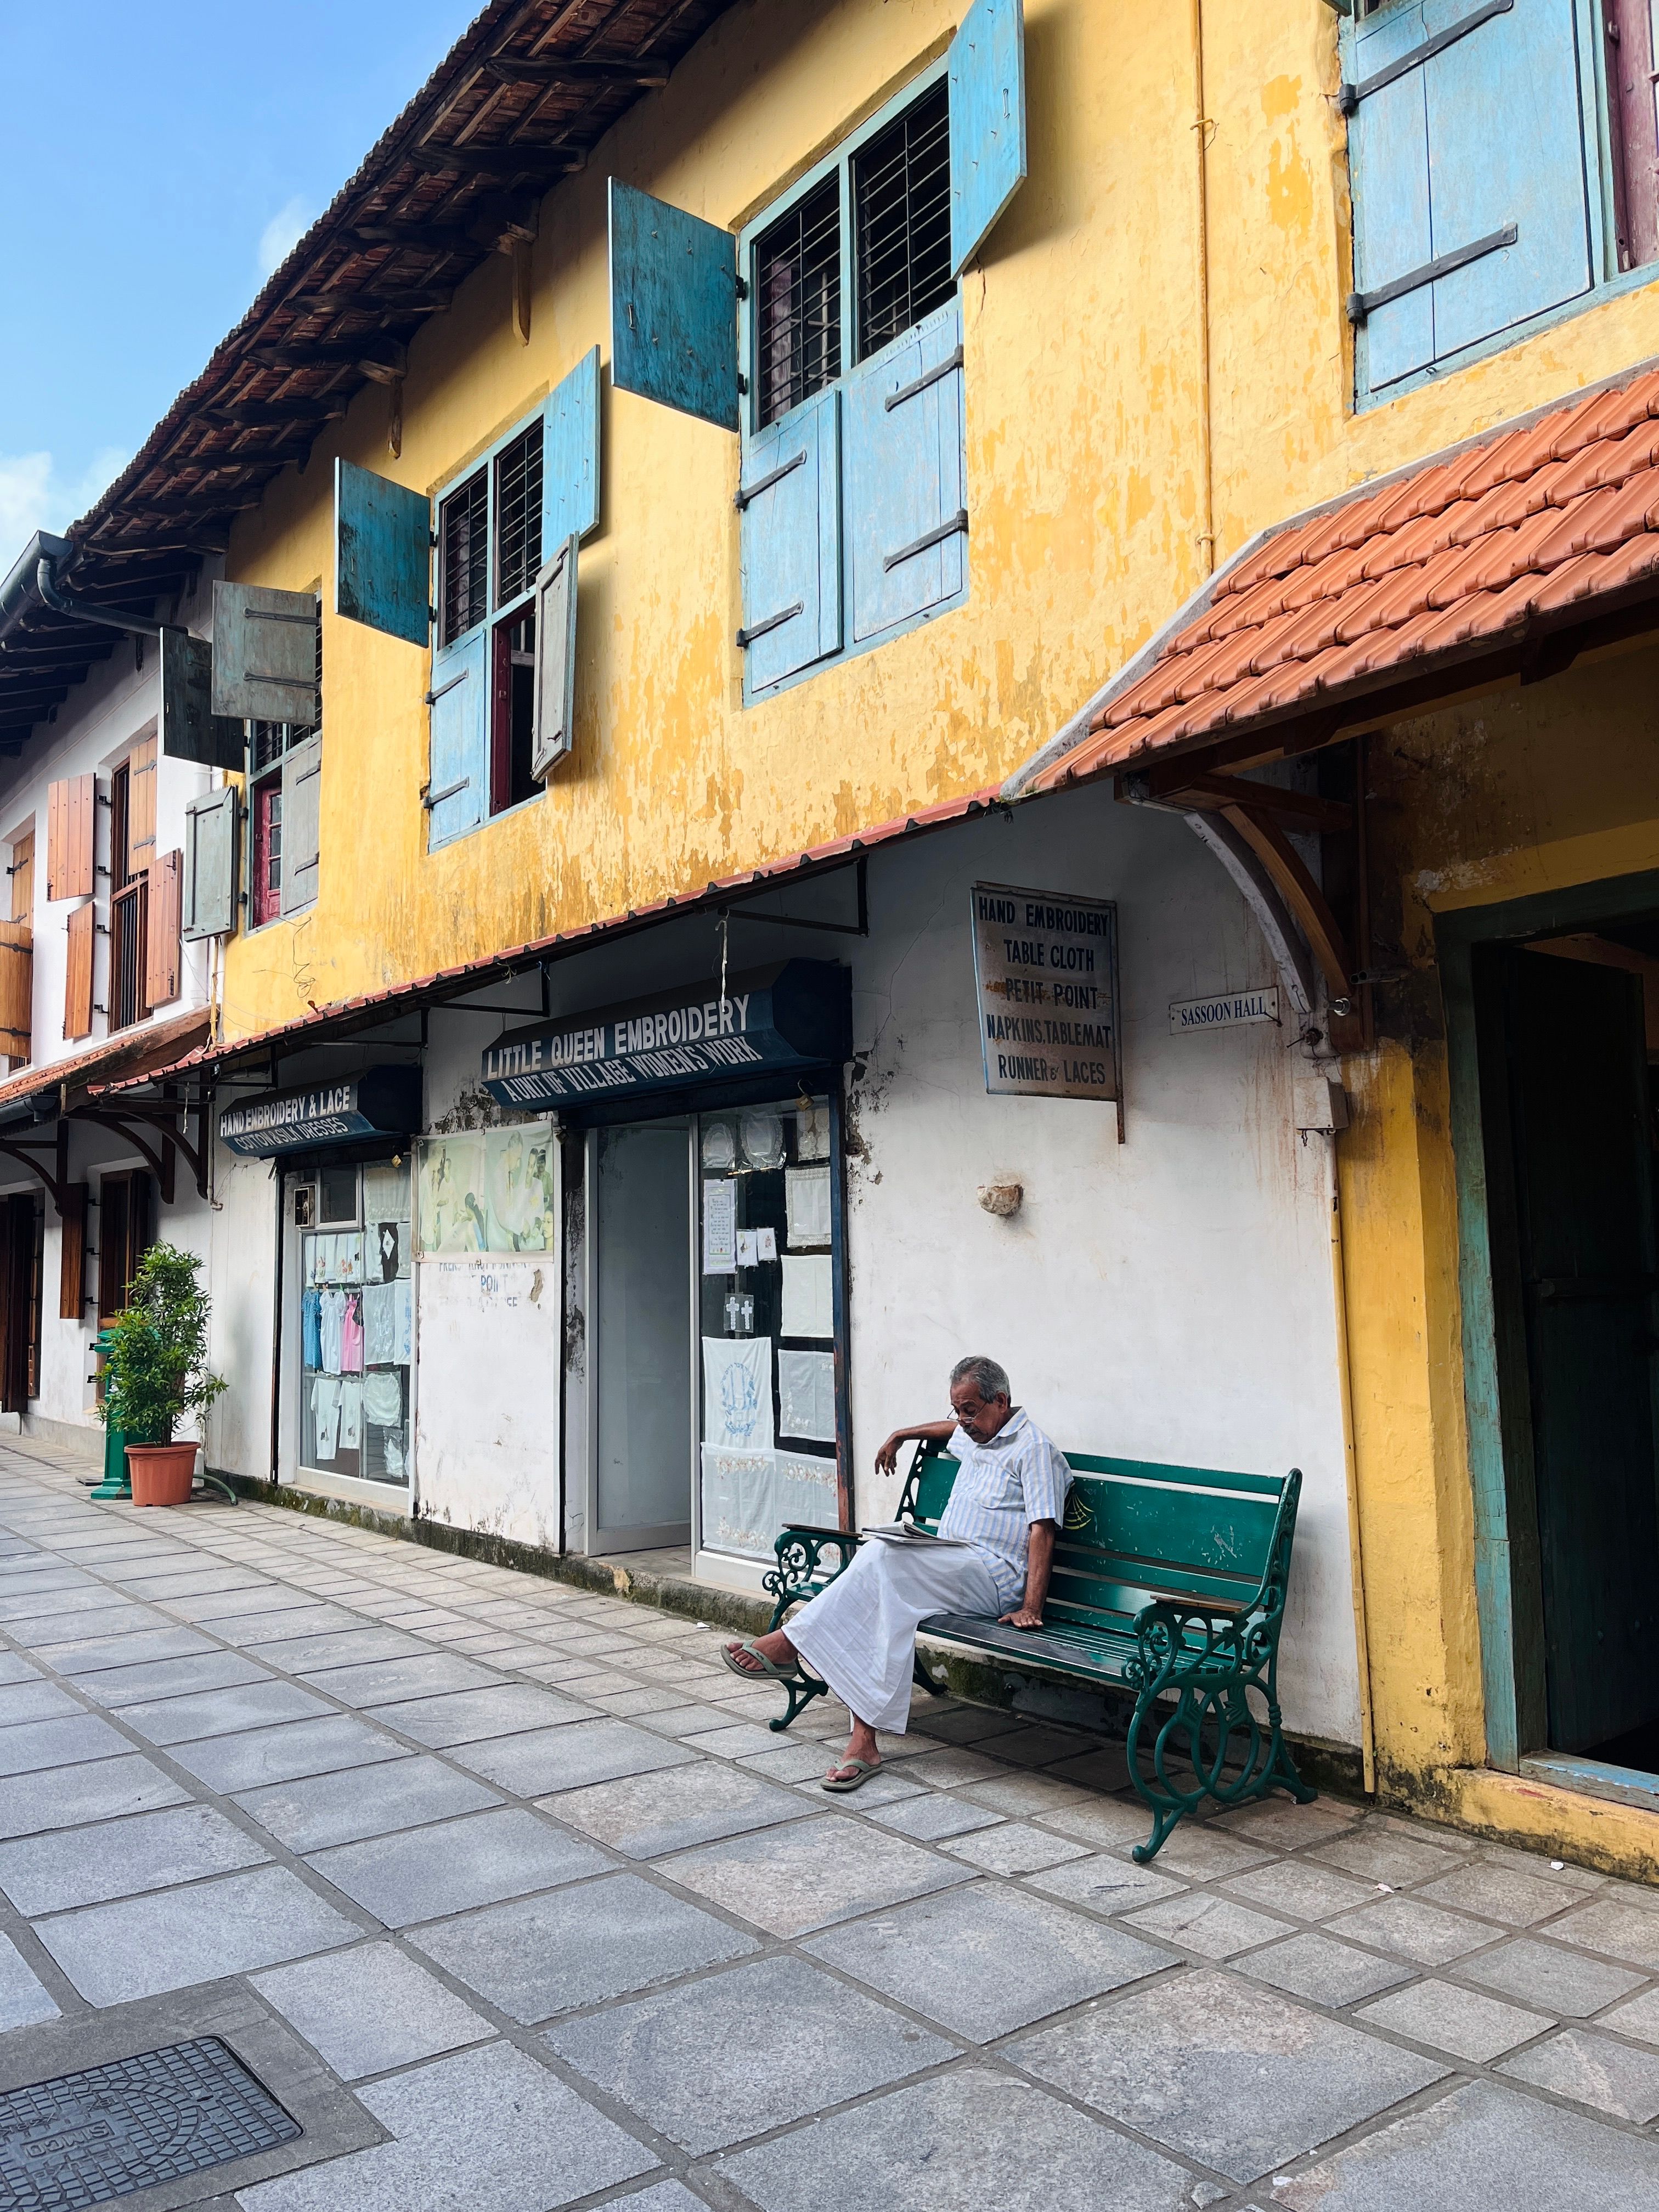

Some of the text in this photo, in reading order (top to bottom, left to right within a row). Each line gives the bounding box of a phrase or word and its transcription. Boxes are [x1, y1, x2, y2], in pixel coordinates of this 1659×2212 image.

[979, 896, 1108, 936] HAND EMBROIDERY
[1003, 939, 1094, 972] TABLE CLOTH
[1006, 978, 1098, 1009] PETIT POINT
[1182, 996, 1266, 1026] SASSOON HALL
[487, 994, 749, 1080] LITTLE QUEEN EMBROIDERY
[501, 1036, 763, 1102] A UNIT OF VILLAGE WOMEN'S WORK
[998, 1054, 1048, 1081] RUNNER
[1063, 1060, 1105, 1085] LACES
[220, 1085, 350, 1137] HAND EMBROIDERY & LACE
[234, 1116, 348, 1150] COTTON & SILK DRESSES
[481, 1274, 508, 1293] POIT
